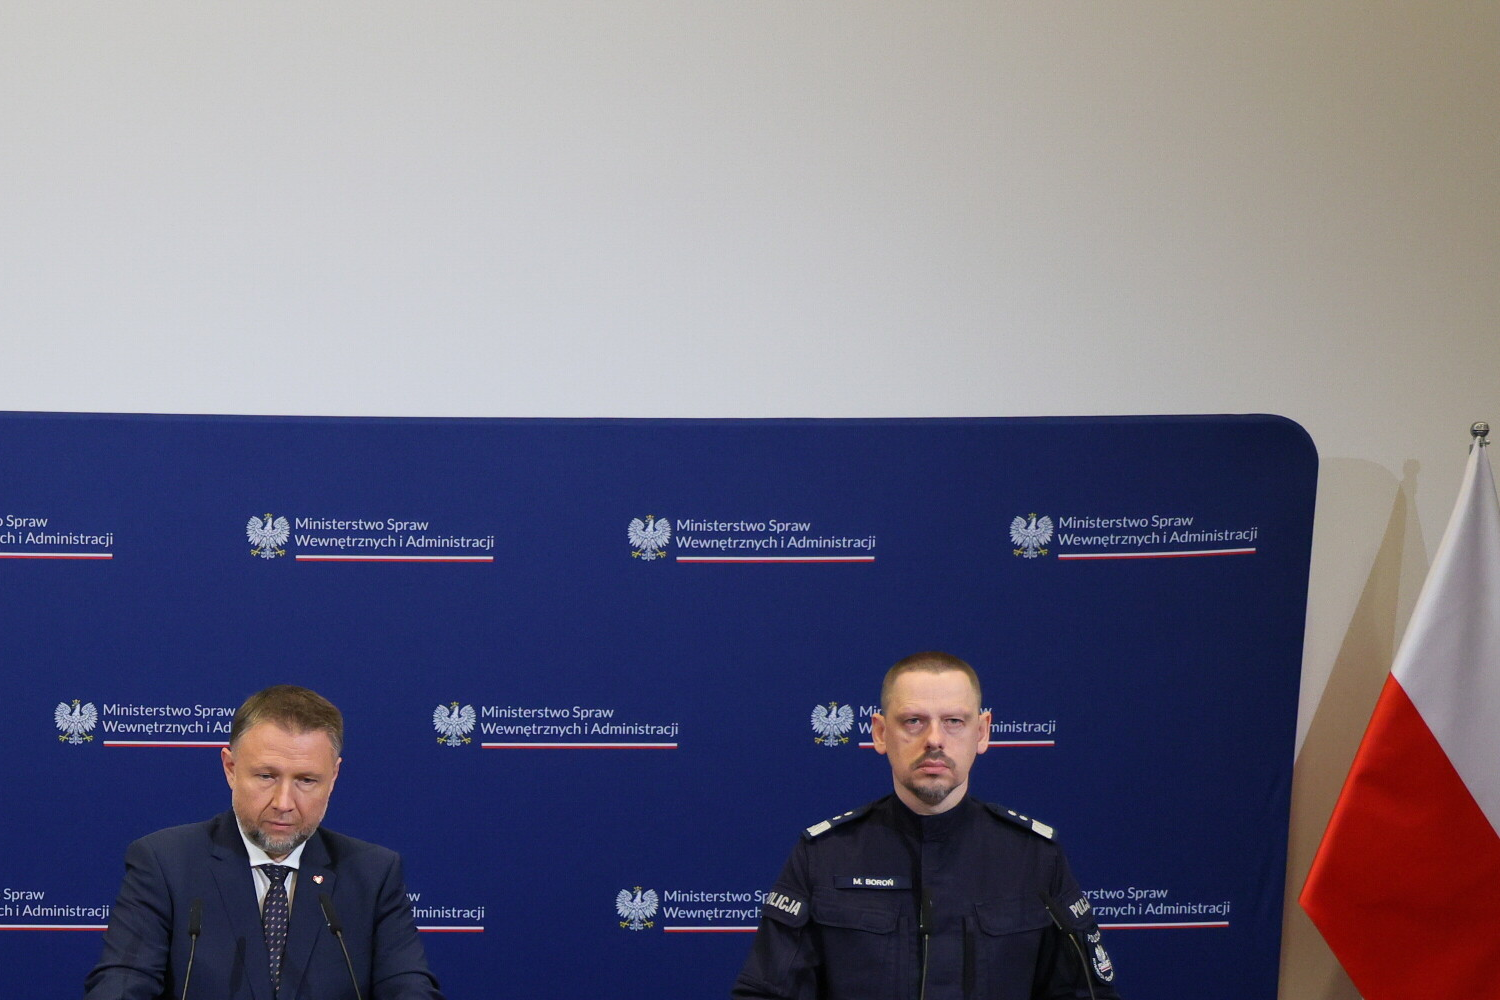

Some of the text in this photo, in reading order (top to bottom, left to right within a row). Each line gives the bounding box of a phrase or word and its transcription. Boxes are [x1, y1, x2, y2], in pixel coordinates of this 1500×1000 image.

[5, 514, 48, 530] Spraw
[295, 517, 429, 534] Ministerstwo Spraw
[676, 518, 811, 534] Ministerstwo Spraw
[1058, 514, 1194, 530] Ministerstwo Spraw
[24, 531, 114, 548] Administracji
[294, 534, 396, 550] Wewnętrznych
[405, 534, 495, 551] Administracji
[675, 535, 778, 551] Wewnętrznych
[786, 535, 876, 551] Administracji
[1057, 531, 1160, 548] Wewnętrznych
[1168, 526, 1258, 544] Administracji
[103, 703, 236, 719] Ministerstwo Spraw
[481, 705, 615, 721] Ministerstwo Spraw
[101, 720, 204, 736] Wewnętrznych
[480, 722, 582, 738] Wewnętrznych
[590, 722, 679, 738] Administracji
[989, 720, 1057, 736] ministracji
[865, 877, 894, 887] BOROŃ
[3, 887, 45, 903] Spraw
[664, 889, 752, 903] Ministerstwo
[1126, 886, 1169, 901] Spraw
[22, 904, 110, 920] Administracji
[410, 905, 485, 921] ministracji
[1091, 902, 1136, 919] rznych
[1144, 900, 1231, 916] Administracji
